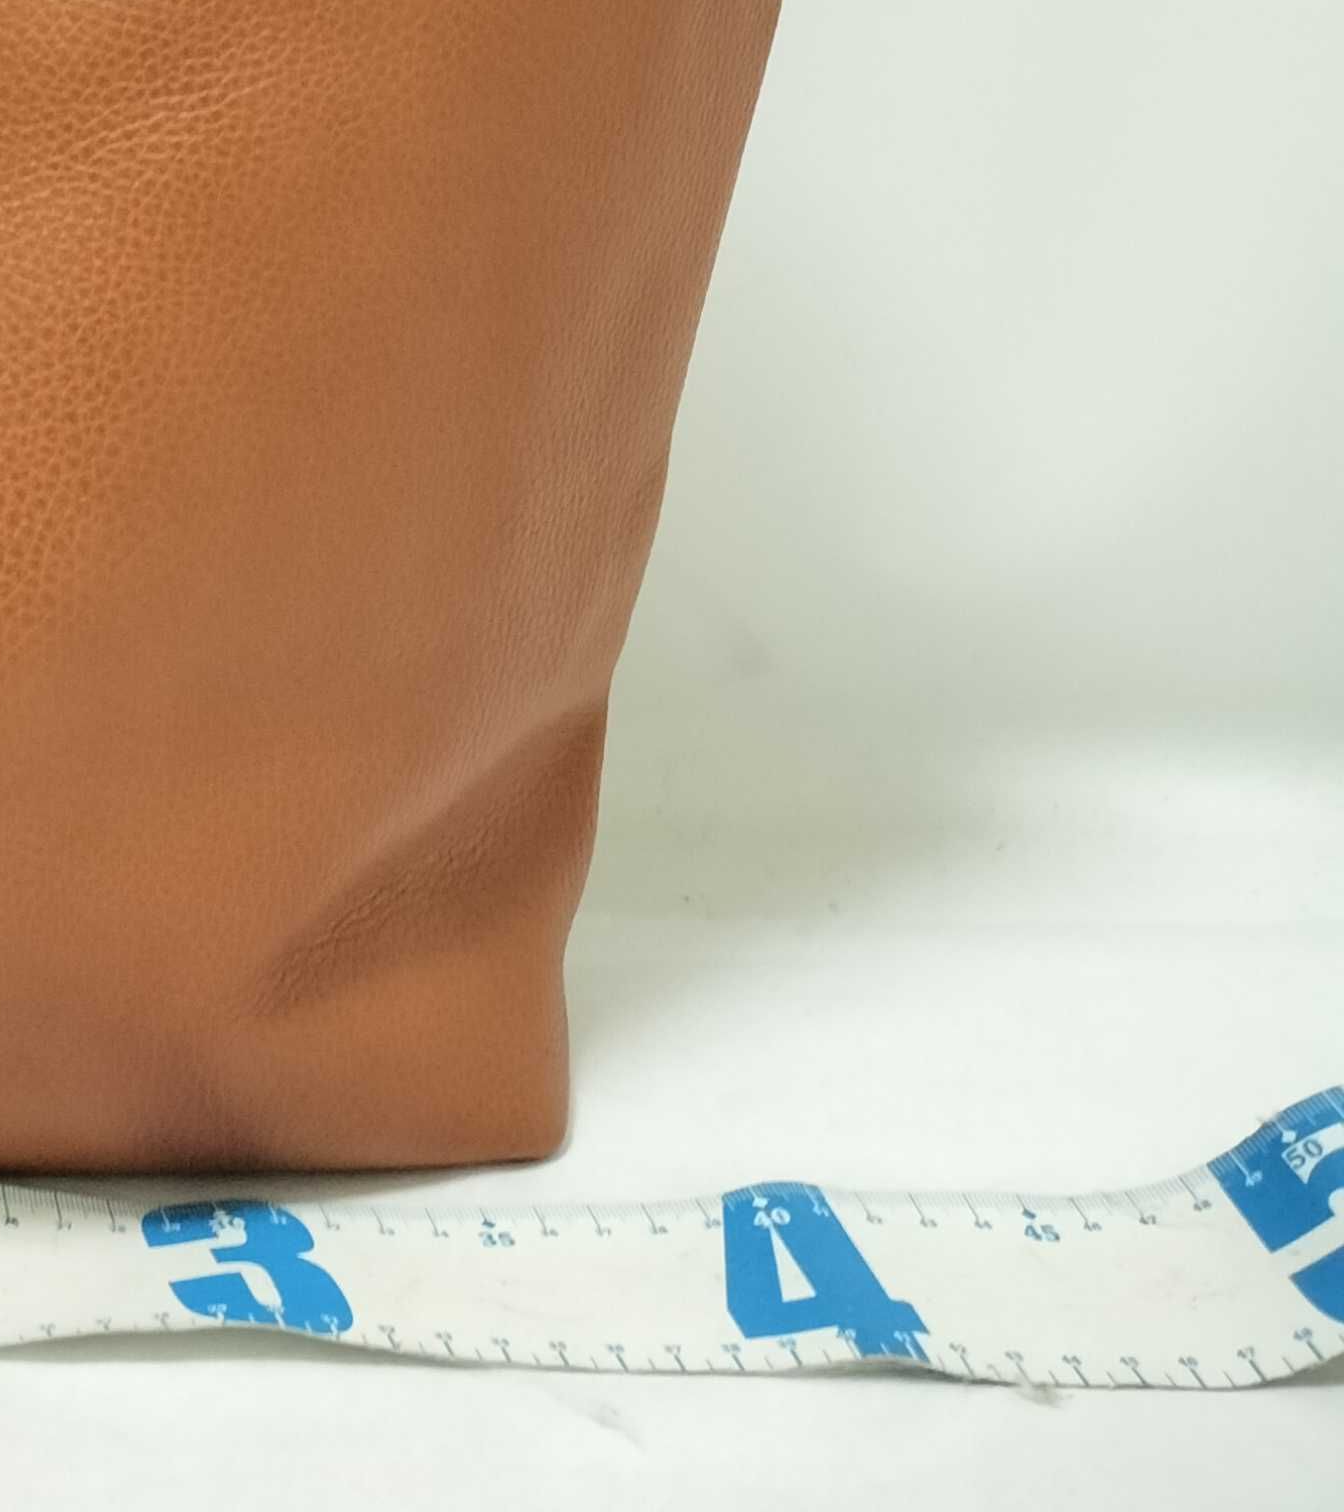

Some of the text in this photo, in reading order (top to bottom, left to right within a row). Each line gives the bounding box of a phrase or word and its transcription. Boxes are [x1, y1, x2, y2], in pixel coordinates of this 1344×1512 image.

[477, 1230, 516, 1248] 35
[753, 1206, 792, 1229] 40
[1023, 1223, 1062, 1243] 45
[1285, 1138, 1324, 1171] 50
[141, 1199, 354, 1334] 3
[721, 1181, 930, 1363] 4
